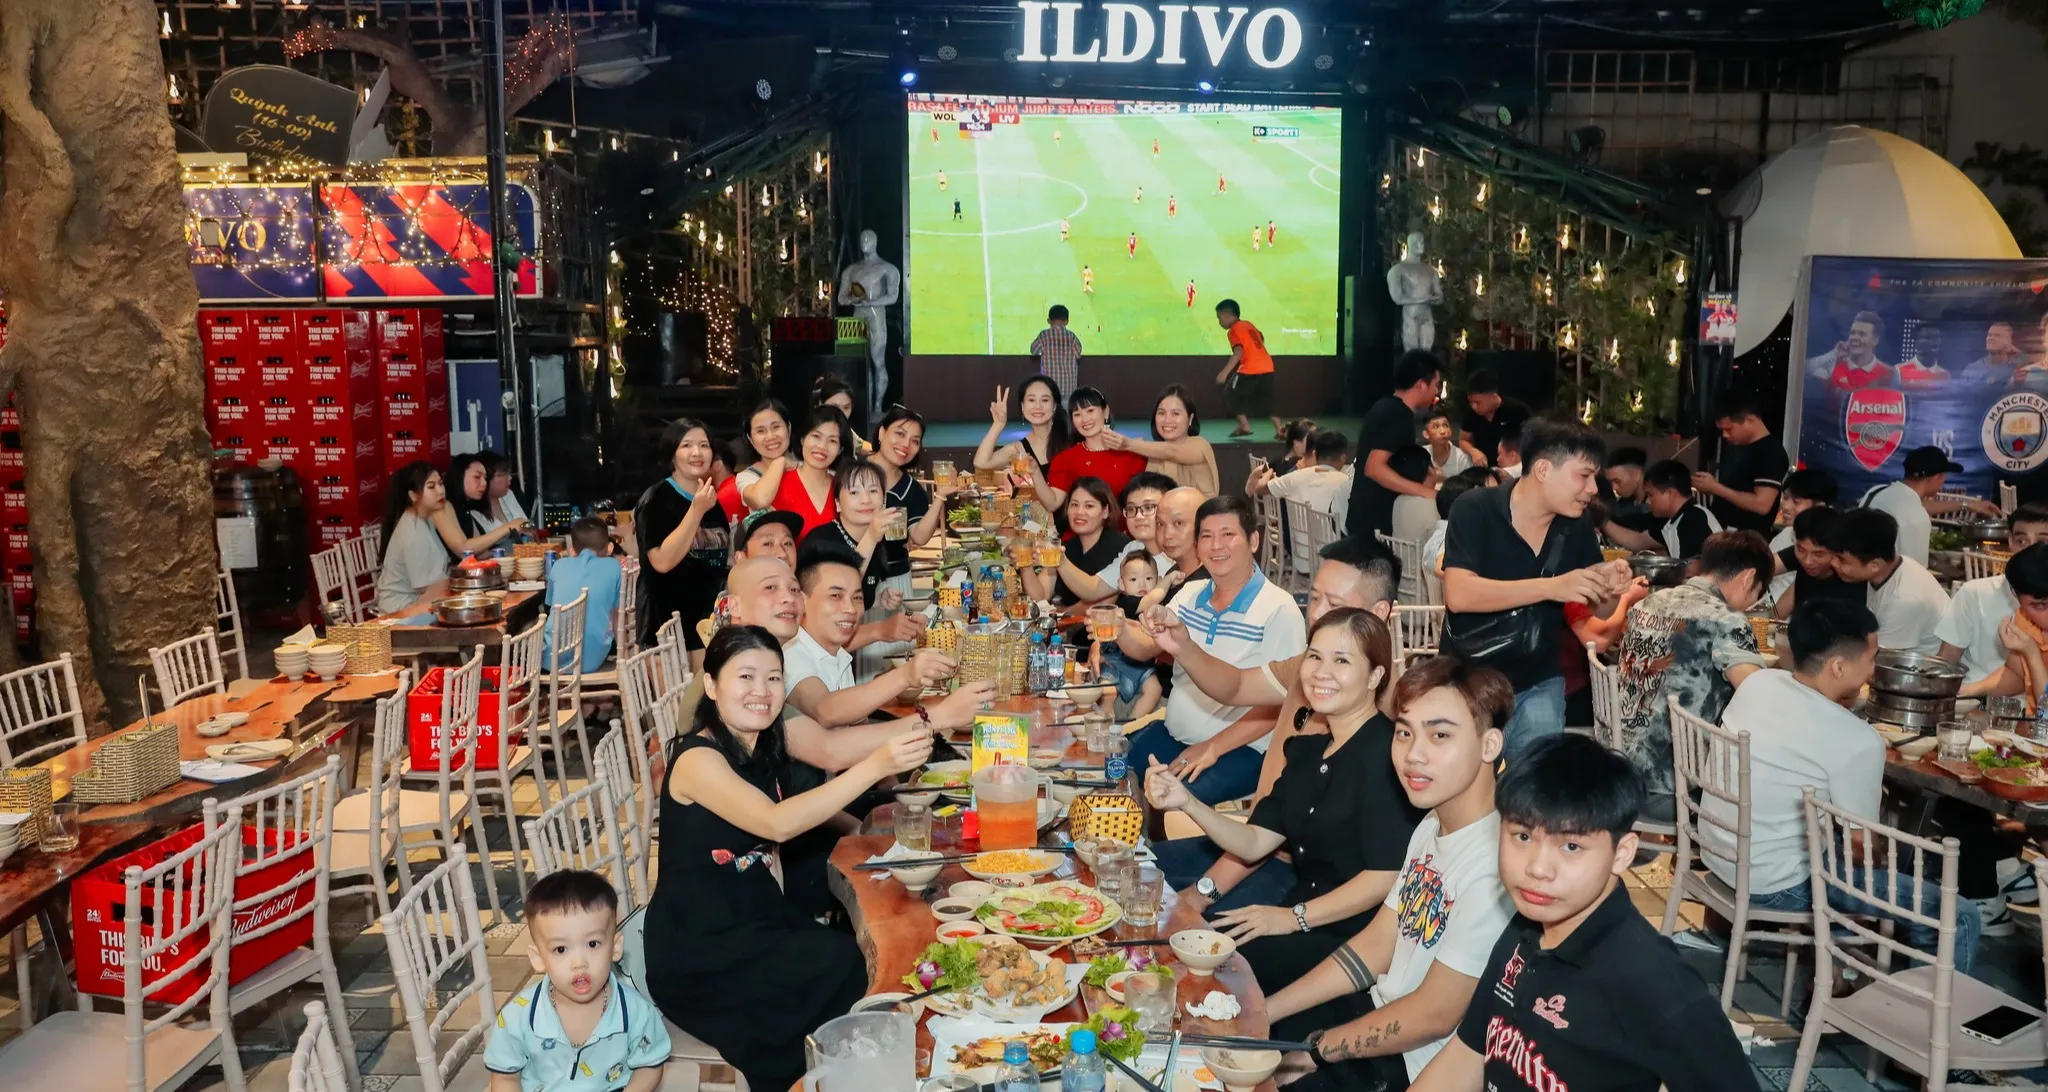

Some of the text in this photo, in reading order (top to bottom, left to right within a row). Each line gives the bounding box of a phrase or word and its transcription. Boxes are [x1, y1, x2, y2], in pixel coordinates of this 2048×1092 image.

[1017, 1, 1302, 68] ILDIVO
[1022, 103, 1055, 114] JUMP
[1187, 103, 1220, 113] START
[933, 113, 956, 121] WOL
[999, 114, 1015, 123] LIV
[1850, 400, 1903, 414] Arsenal
[1989, 395, 2048, 421] MANCHESTE
[2006, 460, 2030, 469] CITY
[429, 725, 456, 737] THS
[99, 929, 126, 948] THI
[141, 954, 166, 973] OU.
